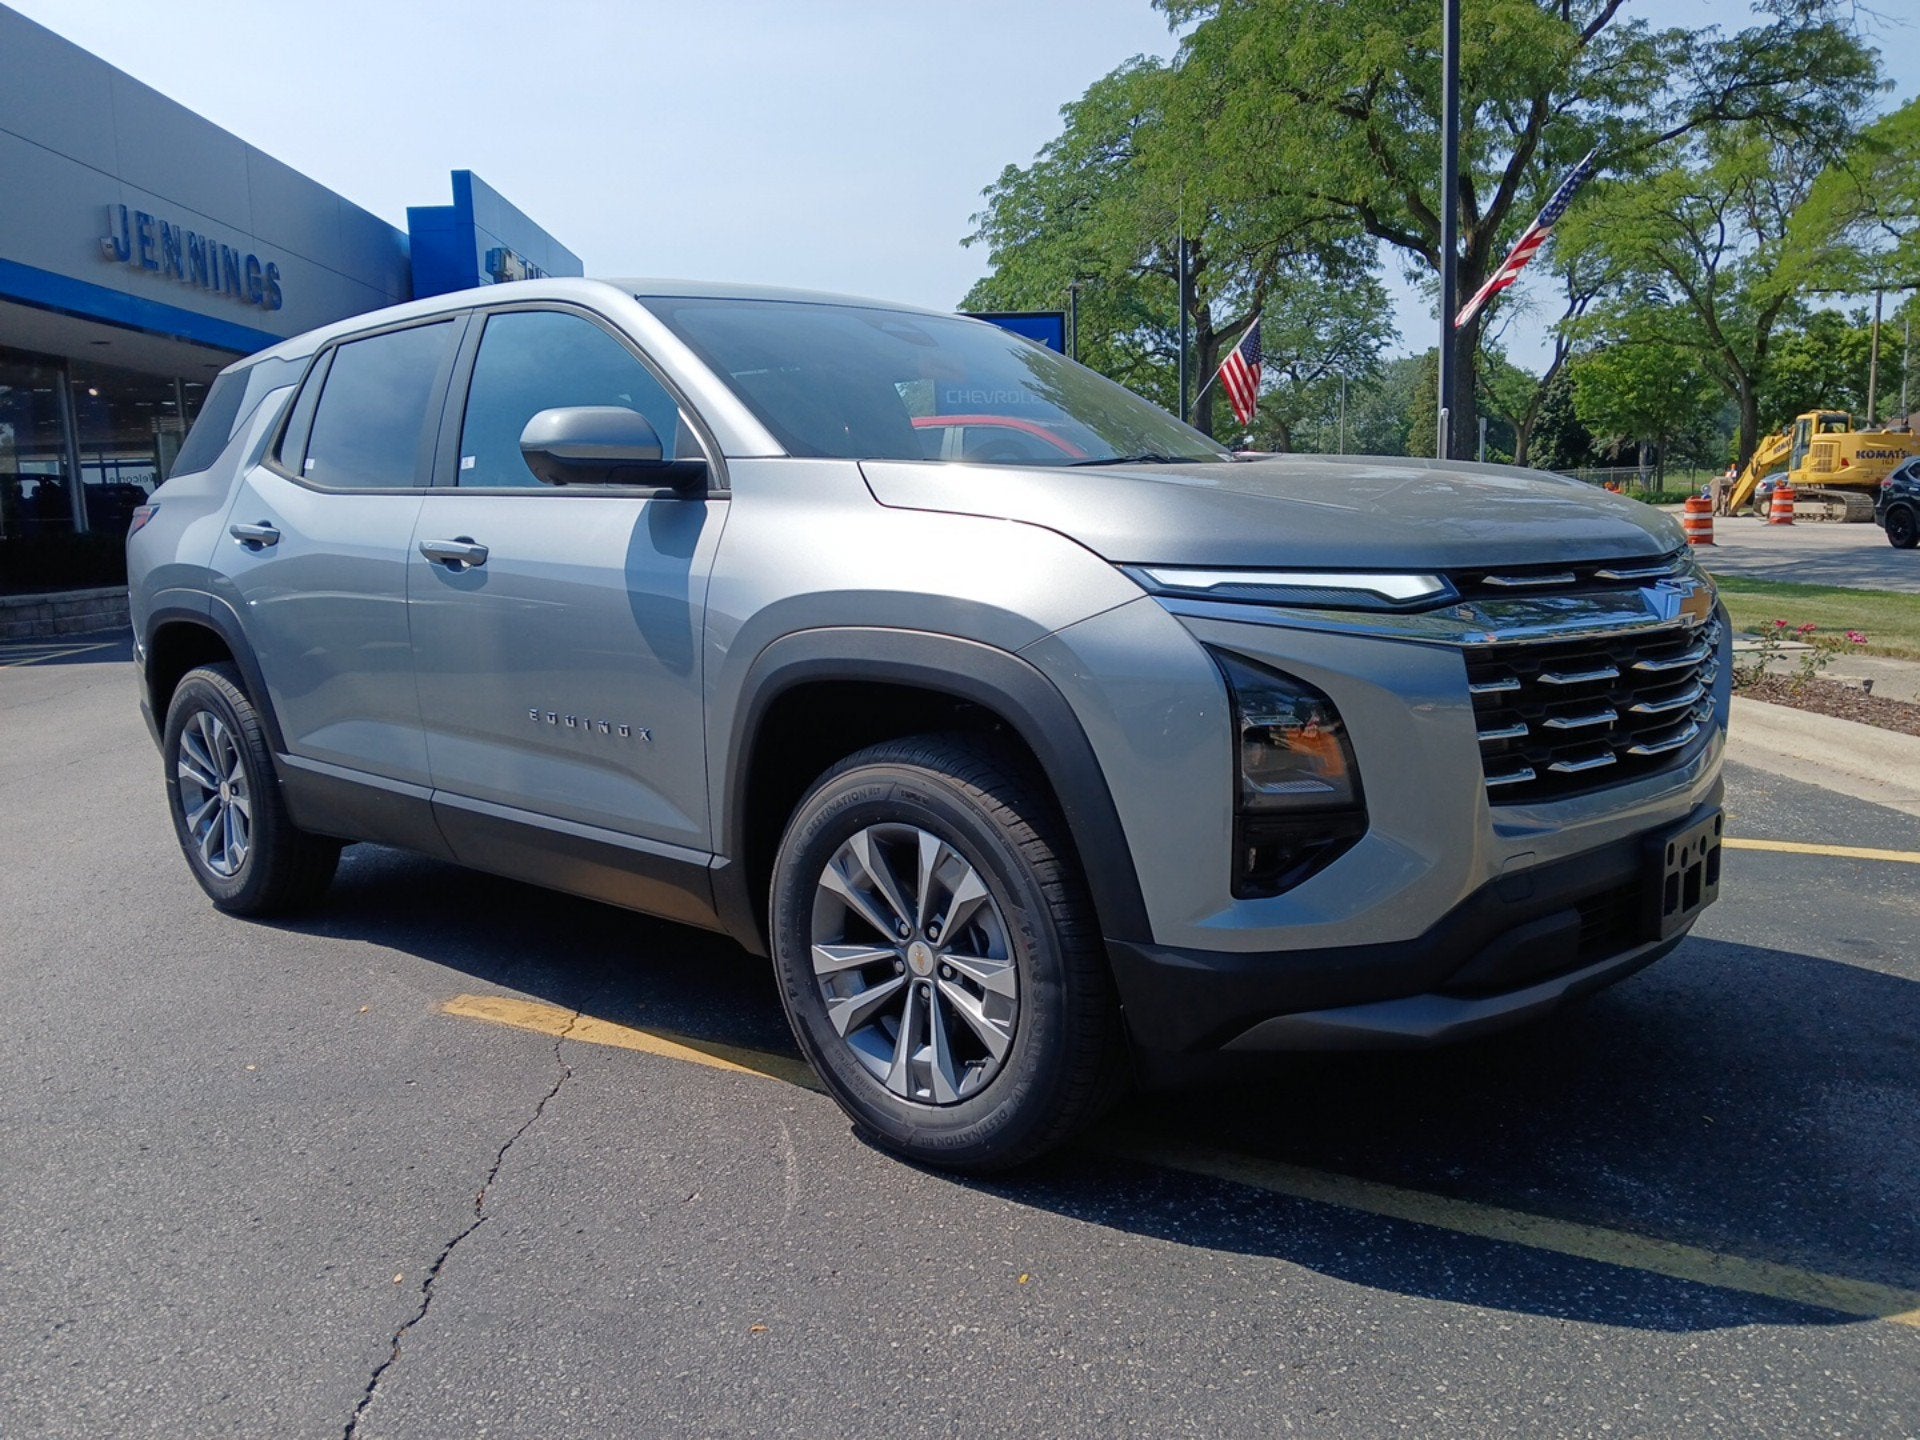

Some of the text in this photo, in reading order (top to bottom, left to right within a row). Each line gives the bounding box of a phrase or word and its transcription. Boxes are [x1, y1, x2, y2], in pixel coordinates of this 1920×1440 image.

[101, 204, 282, 311] JENNINGS
[946, 390, 1042, 404] CHEVROLE
[529, 708, 651, 741] EQUINOX
[807, 789, 868, 836] DESTINATION
[935, 1108, 1009, 1147] DESTINATION
